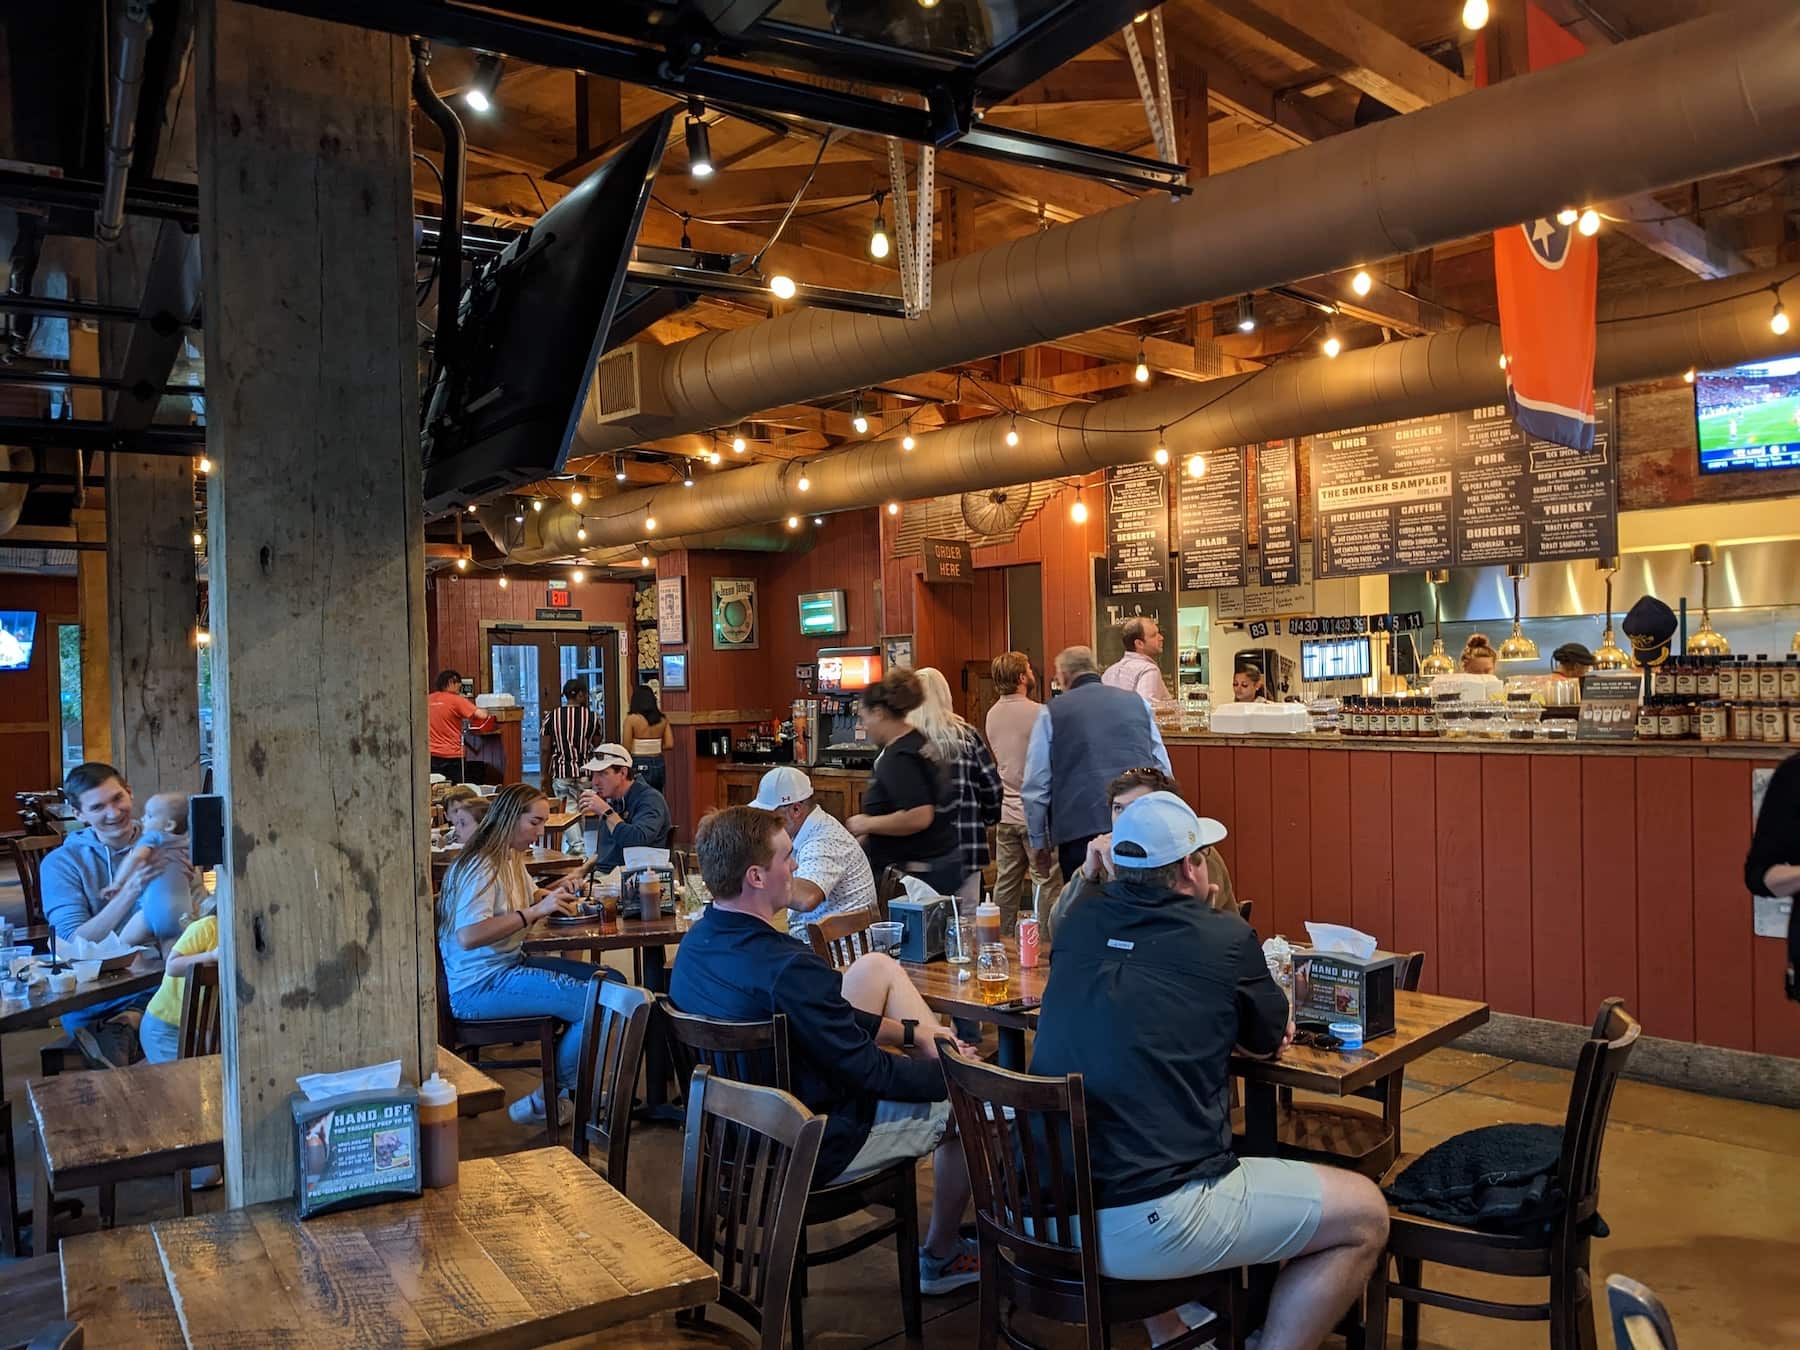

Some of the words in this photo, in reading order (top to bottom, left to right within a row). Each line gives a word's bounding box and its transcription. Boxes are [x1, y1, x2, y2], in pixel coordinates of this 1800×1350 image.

[1473, 405, 1505, 420] RIBS
[1395, 425, 1443, 440] CHICKEN
[1332, 437, 1367, 450] WINGS
[1474, 453, 1506, 465] PORK
[1321, 490, 1341, 500] THE
[1342, 482, 1389, 497] SMOKER
[1391, 475, 1447, 490] SAMPLER
[1331, 514, 1349, 522] HOT
[1350, 508, 1390, 520] CHICKEN
[1401, 502, 1442, 515] CATFISH
[1544, 501, 1592, 515] TURKEY
[1117, 530, 1156, 542] DESSERTS
[1466, 525, 1521, 539] BURGERS
[1195, 536, 1228, 548] SALADS
[935, 544, 962, 560] ORDER
[939, 562, 961, 577] HERE
[1127, 569, 1146, 578] KIDS
[1377, 615, 1385, 630] 4
[1391, 615, 1400, 631] 5
[1408, 613, 1421, 628] 11
[1251, 622, 1267, 637] 83
[1311, 963, 1338, 977] HAND
[1341, 968, 1360, 980] OFF
[334, 1109, 377, 1127] HAND
[383, 1103, 411, 1118] OFF
